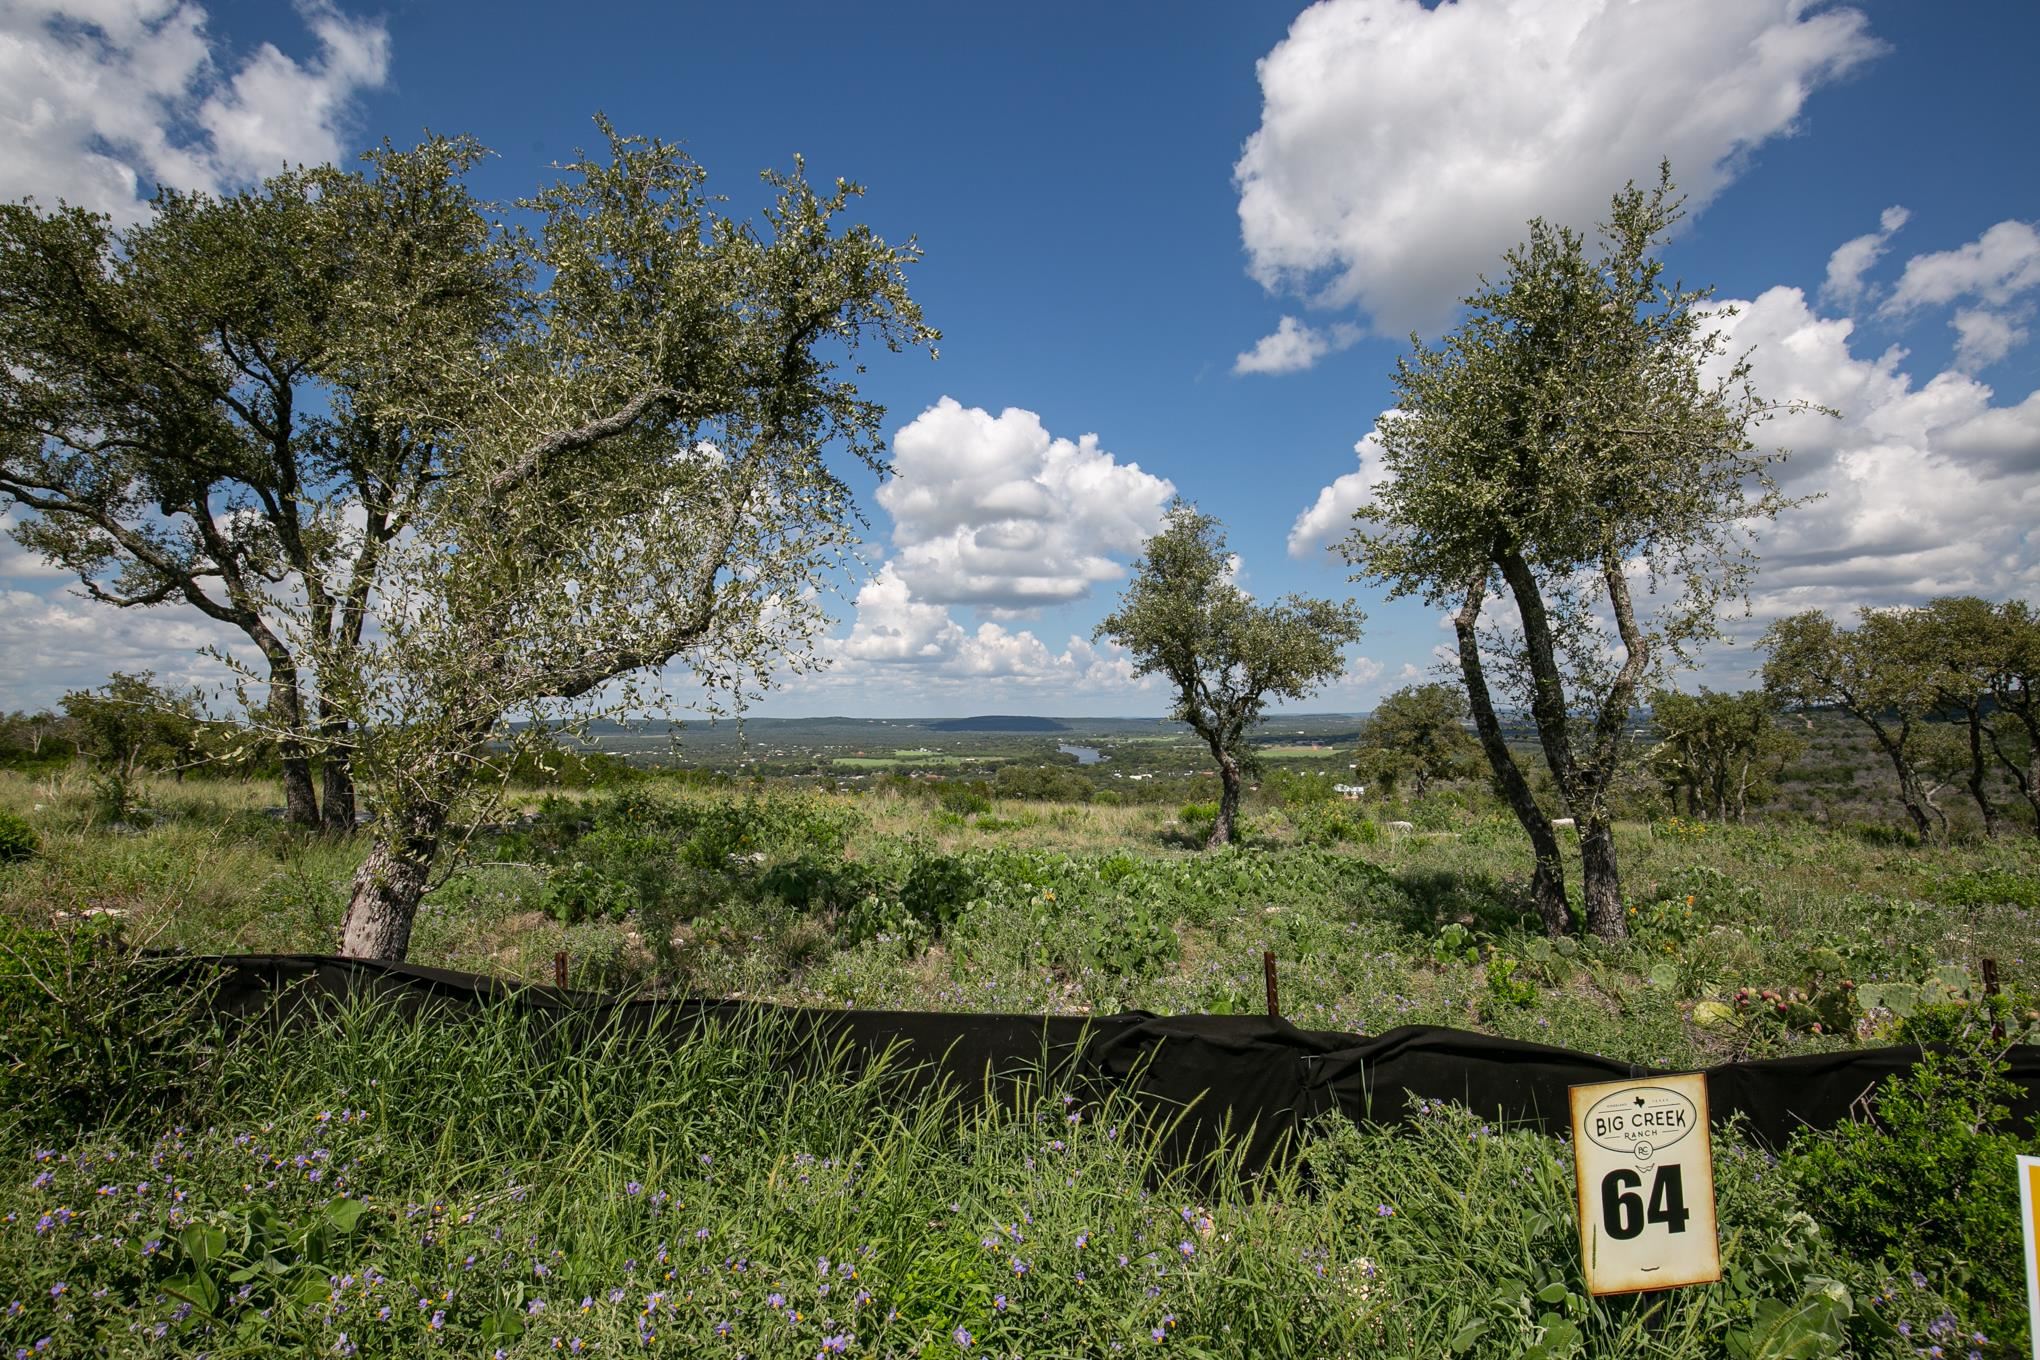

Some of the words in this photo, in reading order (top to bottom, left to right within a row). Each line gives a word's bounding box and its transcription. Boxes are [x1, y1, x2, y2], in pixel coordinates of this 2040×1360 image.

[1596, 1116, 1624, 1137] BIG
[1631, 1109, 1686, 1128] CREEK
[1624, 1130, 1658, 1141] RANCH
[1601, 1163, 1690, 1240] 64
